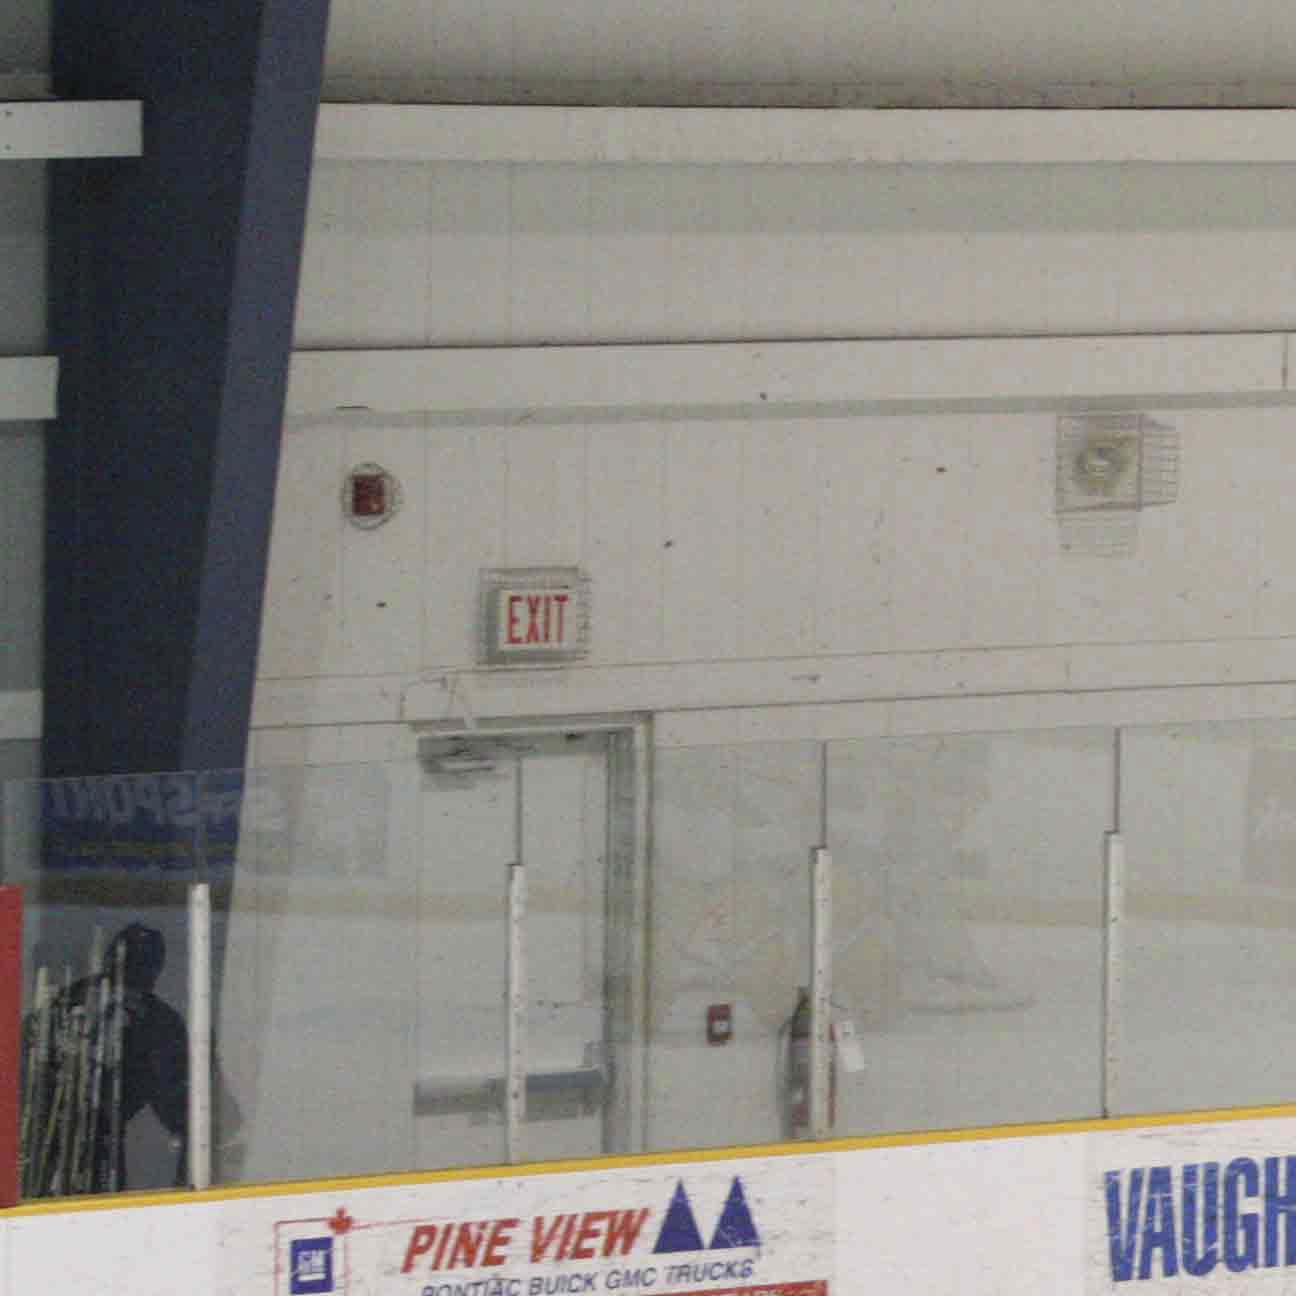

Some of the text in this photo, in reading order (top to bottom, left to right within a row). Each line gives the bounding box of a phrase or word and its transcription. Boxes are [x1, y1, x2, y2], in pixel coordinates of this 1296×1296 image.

[506, 594, 570, 645] EXIT
[400, 1207, 652, 1274] PINE VIEW
[528, 1270, 598, 1296] BUICK
[604, 1265, 658, 1290] GMC
[664, 1257, 755, 1284] TRUCKS
